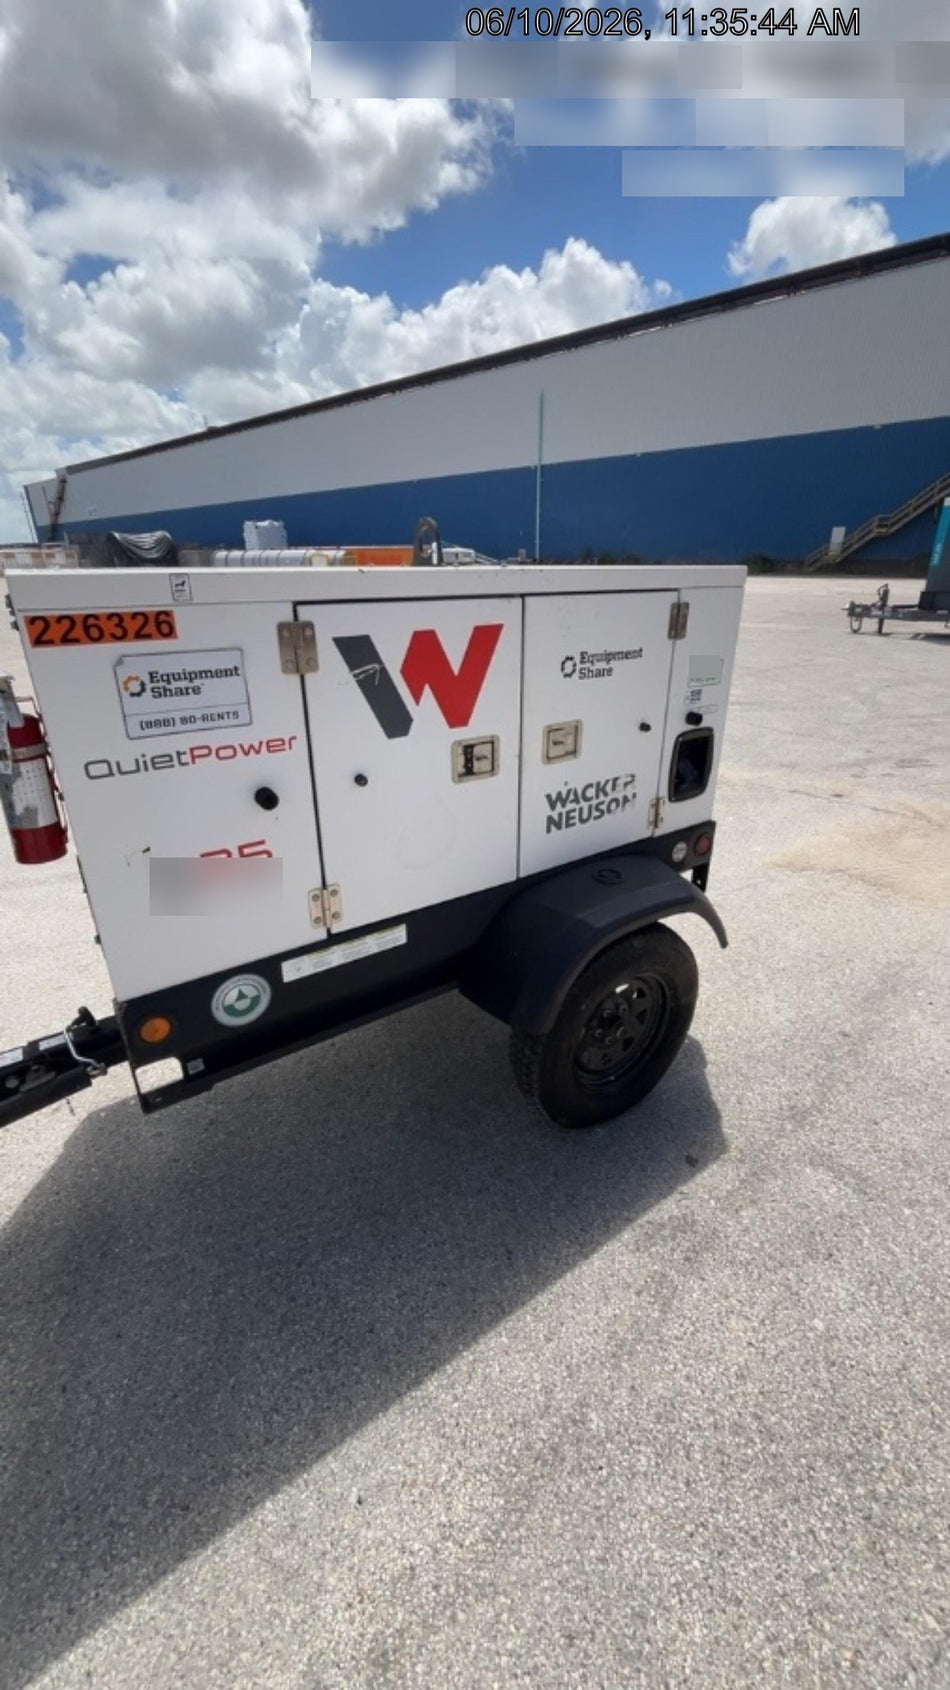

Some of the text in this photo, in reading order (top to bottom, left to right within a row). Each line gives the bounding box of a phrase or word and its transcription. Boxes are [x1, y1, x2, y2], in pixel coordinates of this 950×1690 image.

[28, 610, 175, 646] 226326
[580, 646, 643, 666] Equipment
[148, 665, 241, 686] Equipment
[578, 667, 613, 681] Share
[150, 684, 202, 699] Share
[140, 717, 176, 732] (888)
[84, 735, 298, 781] QuietPower
